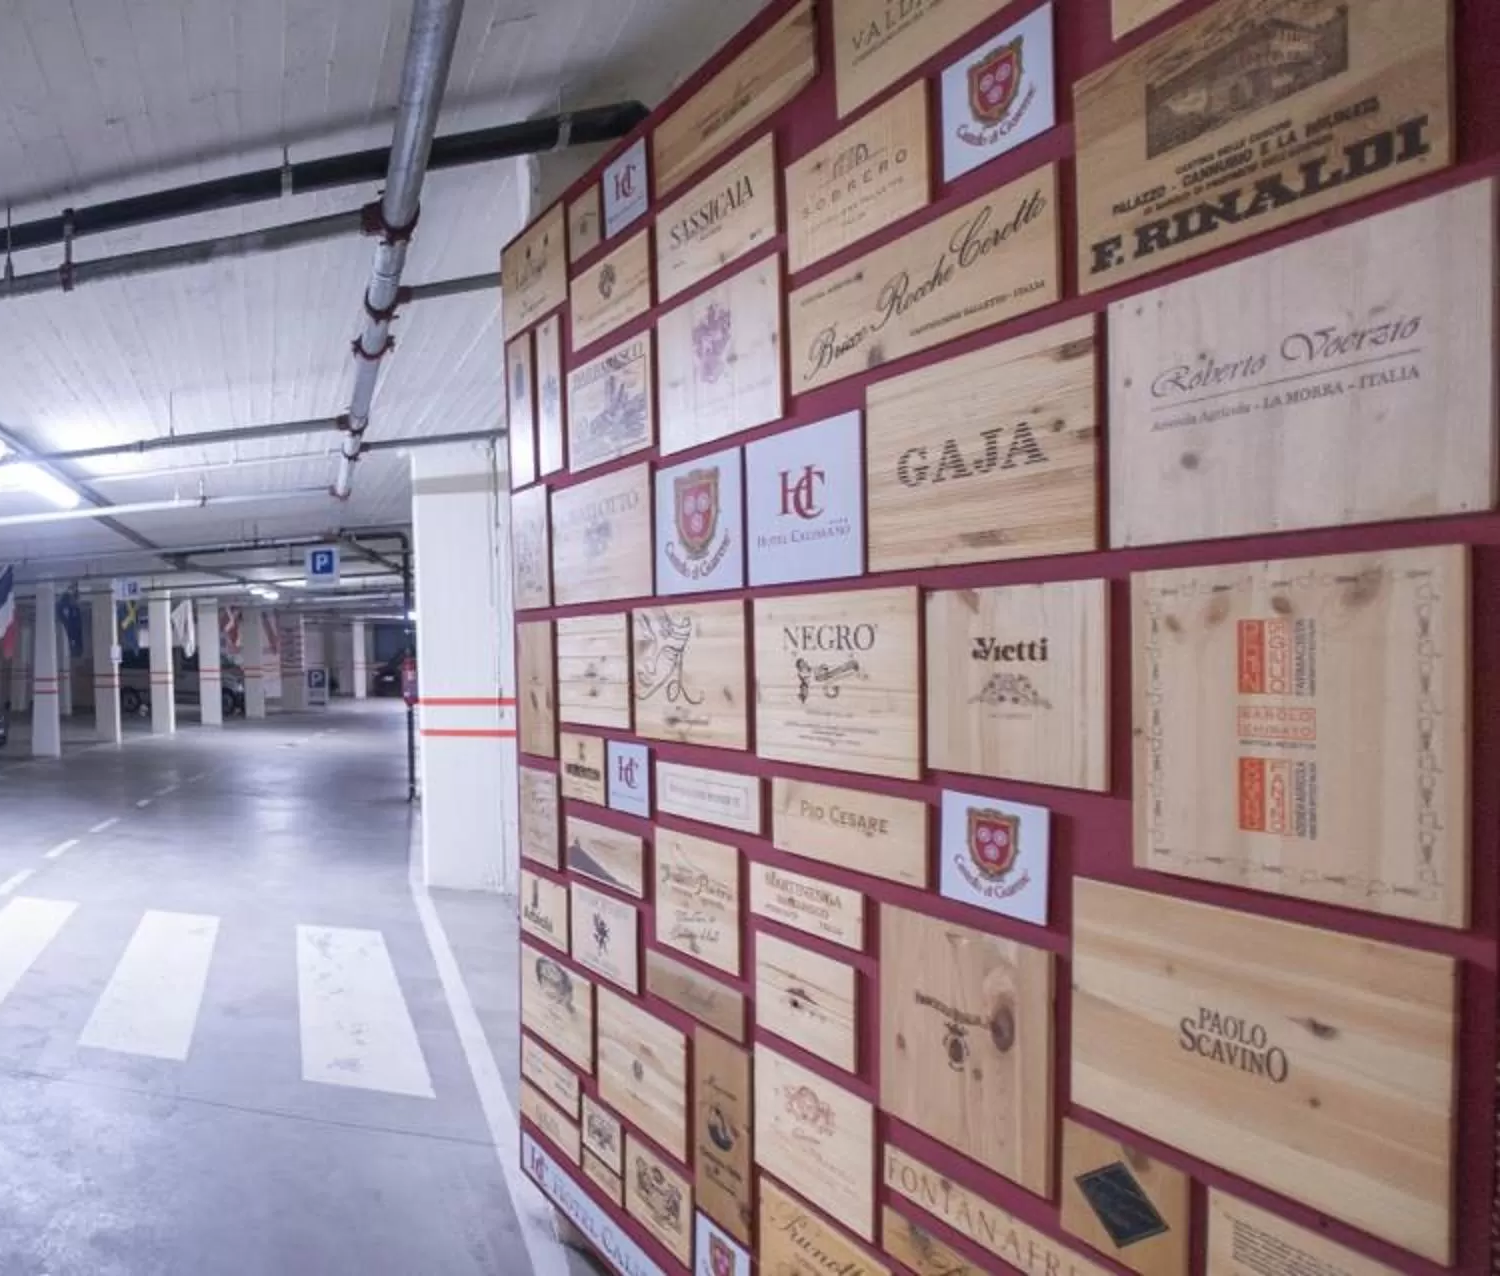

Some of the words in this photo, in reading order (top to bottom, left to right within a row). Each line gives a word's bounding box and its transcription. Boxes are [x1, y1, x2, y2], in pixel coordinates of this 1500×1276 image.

[669, 175, 754, 250] SASSICAIA
[1089, 232, 1126, 276] F.
[1132, 114, 1431, 259] RINALDI
[1151, 354, 1268, 399] Roberto
[1280, 315, 1422, 362] Voerzio
[1358, 363, 1420, 390] ITALIA
[897, 420, 1050, 489] GAJA
[784, 623, 875, 652] NEGRO
[972, 636, 1049, 662] Vietti
[830, 805, 890, 834] CESARE
[1179, 1016, 1289, 1083] SCAVINO
[1198, 1007, 1268, 1049] PAOLO
